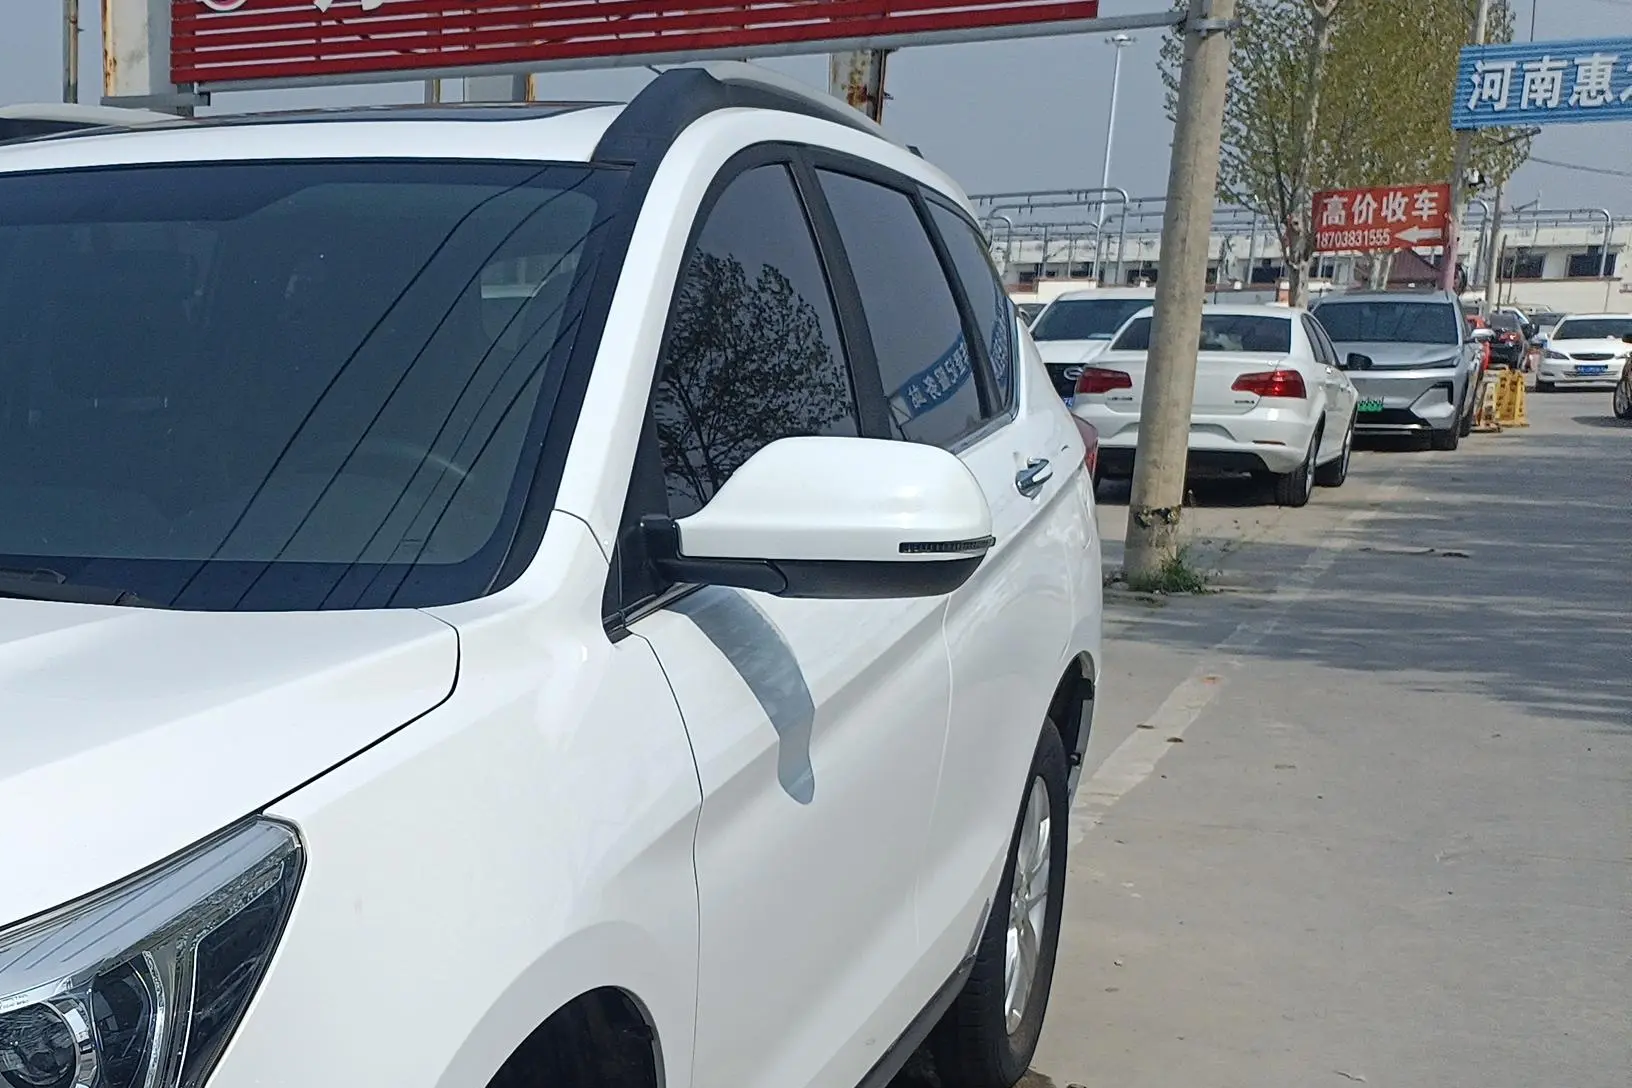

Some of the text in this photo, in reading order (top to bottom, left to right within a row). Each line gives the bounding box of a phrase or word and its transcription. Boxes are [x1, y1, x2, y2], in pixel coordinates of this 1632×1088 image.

[1468, 52, 1632, 112] 河南惠
[1322, 188, 1439, 226] 高价收车
[1315, 227, 1390, 249] 18703831555
